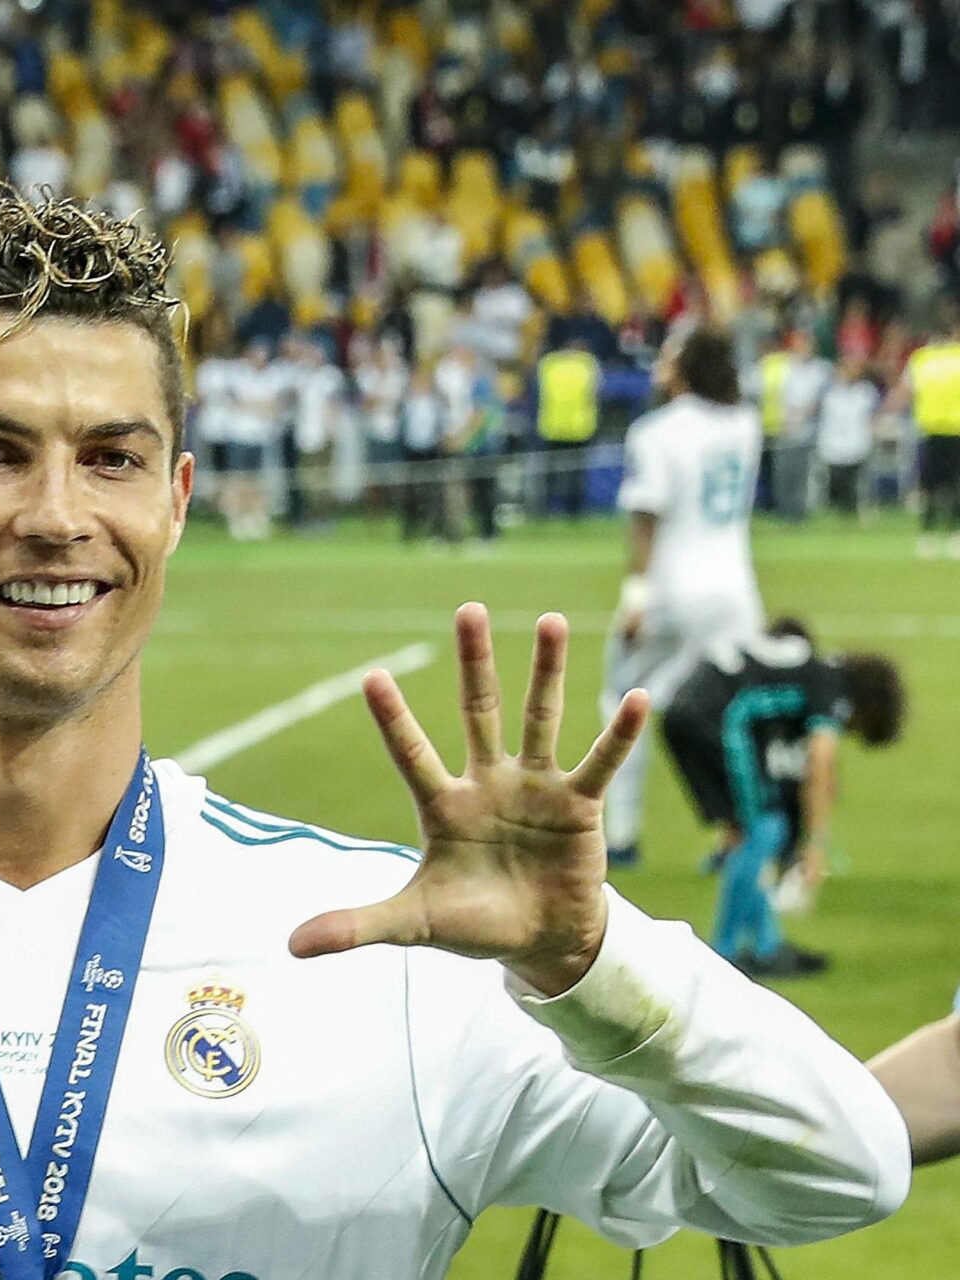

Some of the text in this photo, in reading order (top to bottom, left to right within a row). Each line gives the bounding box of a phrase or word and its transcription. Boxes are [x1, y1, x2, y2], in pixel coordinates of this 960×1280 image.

[0, 1031, 43, 1046] KYIV
[68, 1003, 108, 1085] FINAL
[51, 1090, 87, 1158] KYIV
[37, 1161, 69, 1221] 2018
